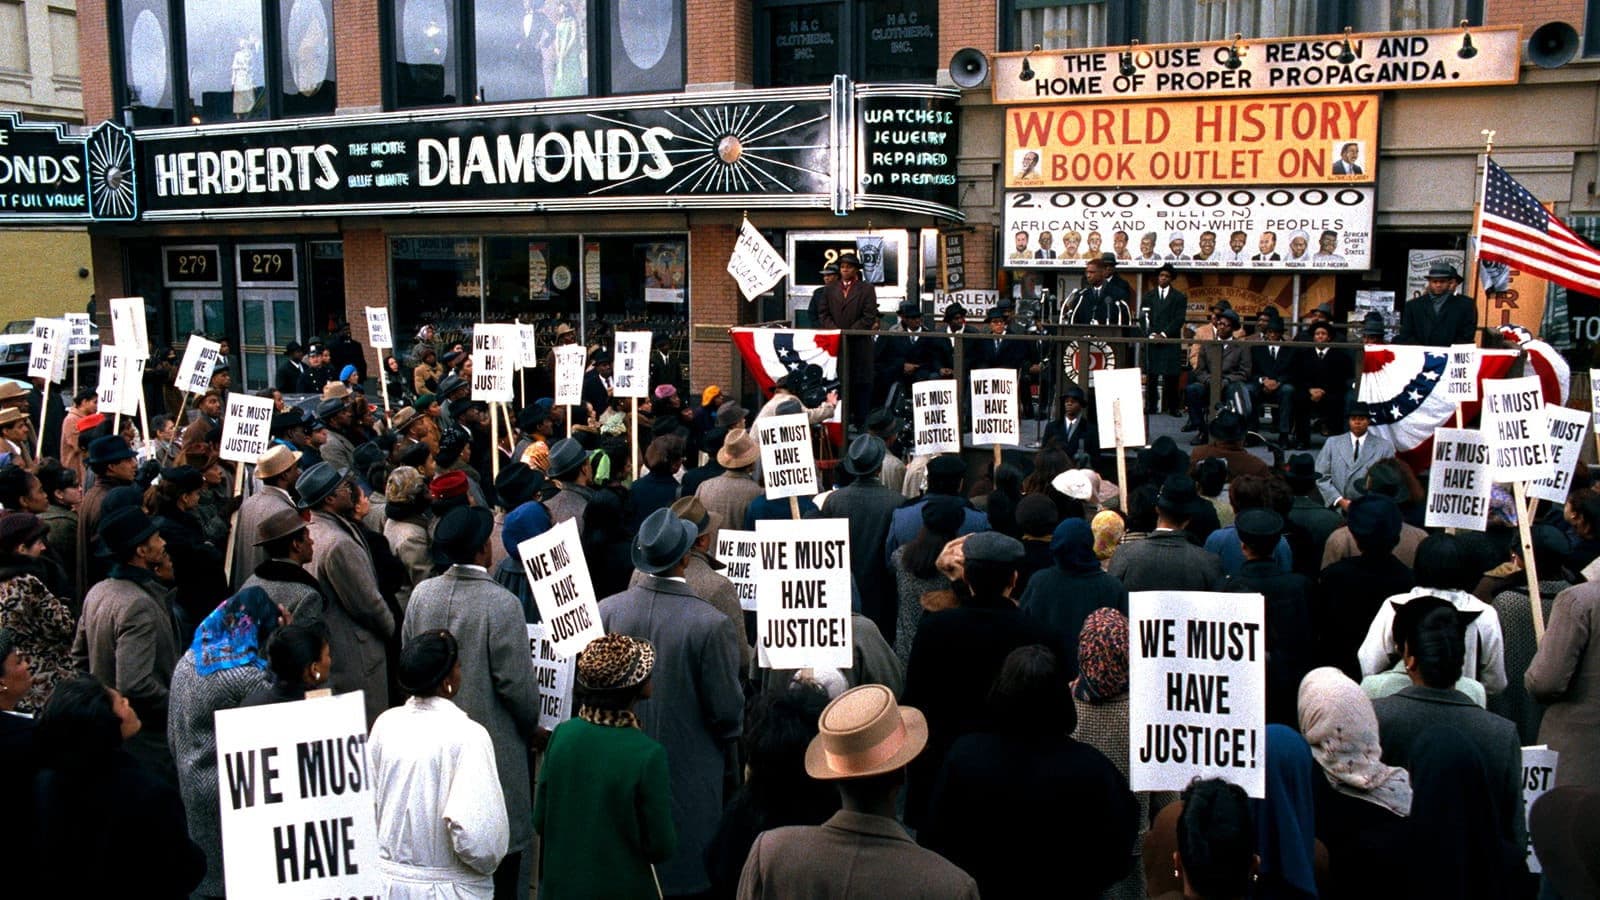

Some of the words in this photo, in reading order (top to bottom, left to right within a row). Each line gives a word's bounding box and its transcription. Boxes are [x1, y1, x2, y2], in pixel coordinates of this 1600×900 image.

[1063, 54, 1107, 72] THE
[1377, 37, 1428, 58] AND
[1035, 76, 1102, 96] HOME
[1113, 74, 1146, 92] OF
[1157, 70, 1252, 91] PROPER
[1269, 60, 1461, 87] PROPAGANDA.
[864, 109, 942, 124] WATCHES
[1013, 107, 1171, 148] WORLD
[1196, 100, 1370, 144] HISTORY
[874, 131, 947, 144] JEWELRY
[348, 143, 369, 156] THE
[418, 126, 674, 187] DIAMONDS
[873, 152, 948, 165] REPAIRED
[155, 143, 341, 197] HERBERTS
[1051, 153, 1136, 182] BOOK
[1149, 149, 1263, 180] OUTLET
[1278, 147, 1325, 179] ON
[862, 173, 884, 184] ON
[45, 194, 85, 207] VALUE
[1083, 208, 1133, 219] (TWO
[1157, 207, 1252, 219] BILLION)
[1011, 220, 1099, 231] AFRICANS
[1112, 220, 1146, 231] AND
[1165, 219, 1254, 230] NON-WHITE
[1266, 218, 1344, 230] PEOPLES
[179, 255, 207, 273] 279
[252, 254, 282, 273] 279
[936, 293, 996, 305] HARLEM
[475, 335, 490, 350] WE
[104, 355, 118, 369] WE
[973, 379, 988, 395] WE
[915, 392, 927, 408] WE
[929, 390, 953, 406] MUST
[984, 398, 1008, 414] HAVE
[1503, 390, 1539, 413] MUST
[230, 403, 244, 416] WE
[247, 404, 271, 421] MUST
[925, 409, 947, 425] HAVE
[237, 423, 259, 437] HAVE
[760, 428, 776, 445] WE
[779, 424, 807, 443] MUST
[917, 428, 956, 445] JUSTICE!
[1498, 420, 1530, 441] HAVE
[225, 440, 265, 455] JUSTICE!
[774, 447, 800, 465] HAVE
[1435, 442, 1451, 462] WE
[768, 468, 813, 488] JUSTICE!
[1443, 470, 1474, 490] HAVE
[1429, 494, 1486, 517] JUSTICE!
[719, 540, 734, 556] WE
[736, 541, 756, 558] MUS
[761, 541, 787, 571] WE
[795, 540, 846, 569] MUST
[526, 553, 551, 582] WE
[726, 562, 750, 578] HAVE
[551, 573, 579, 608] HAVE
[734, 582, 757, 600] TICE!
[781, 580, 828, 609] HAVE
[763, 618, 846, 648] JUSTICE!
[1139, 619, 1176, 658] WE
[1187, 620, 1260, 661] MUST
[529, 638, 537, 658] E
[535, 666, 557, 689] AVE
[1167, 672, 1231, 714] HAVE
[539, 694, 562, 718] TICE!
[1139, 724, 1256, 768] JUSTICE!
[225, 747, 283, 810] WE
[273, 816, 359, 884] HAVE
